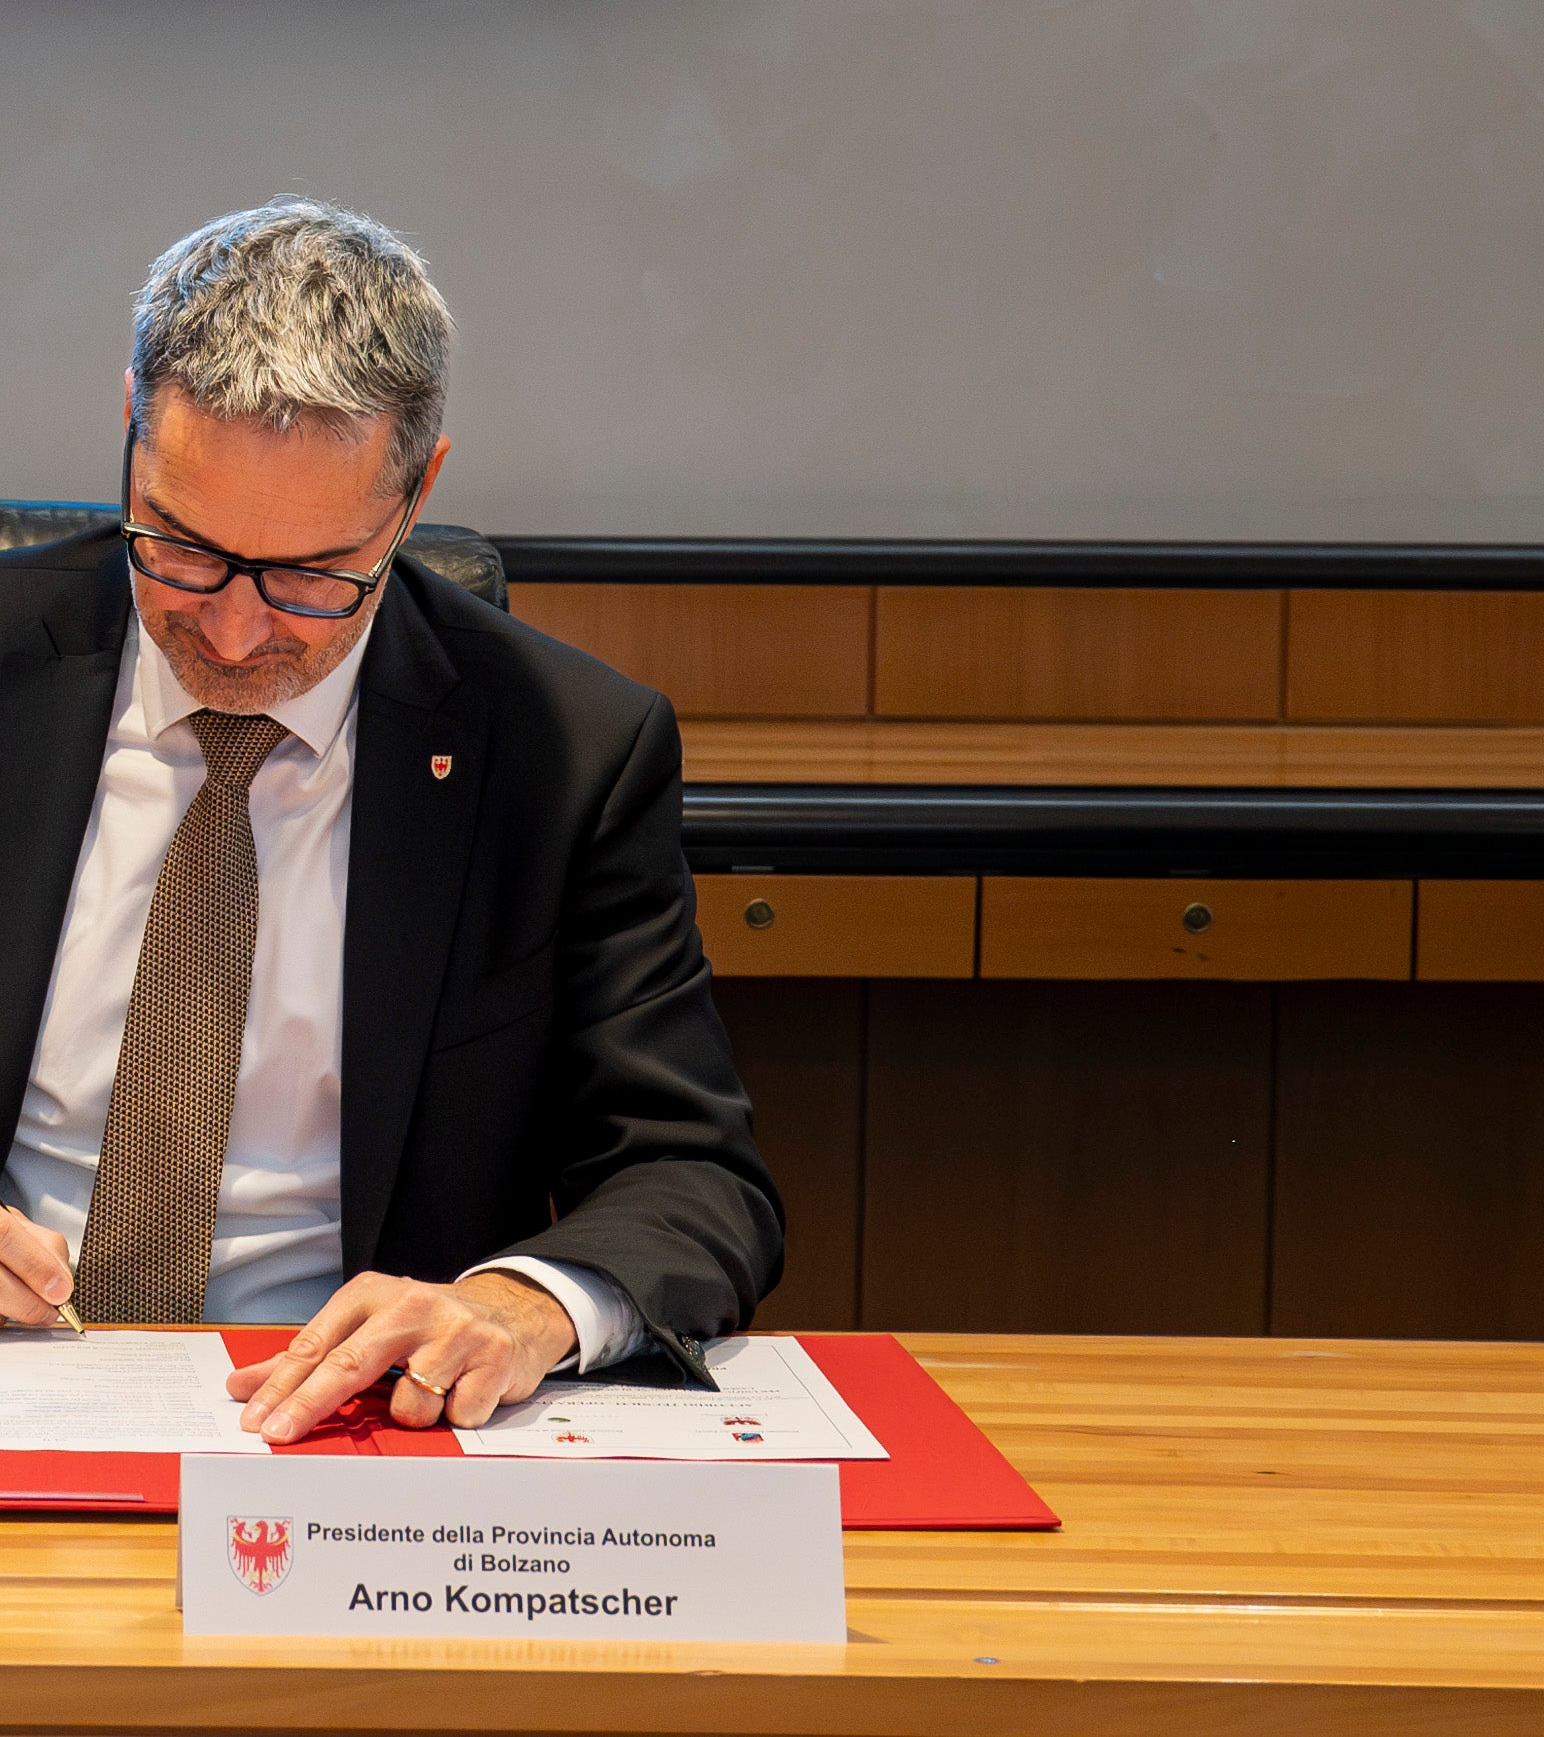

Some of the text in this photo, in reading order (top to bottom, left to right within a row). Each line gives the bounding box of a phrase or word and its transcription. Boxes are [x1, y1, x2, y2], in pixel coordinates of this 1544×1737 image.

[307, 1521, 716, 1549] Presidente della Provincia Autonoma
[453, 1552, 571, 1574] di Bolzano
[348, 1582, 679, 1622] Arno Kompatscher
